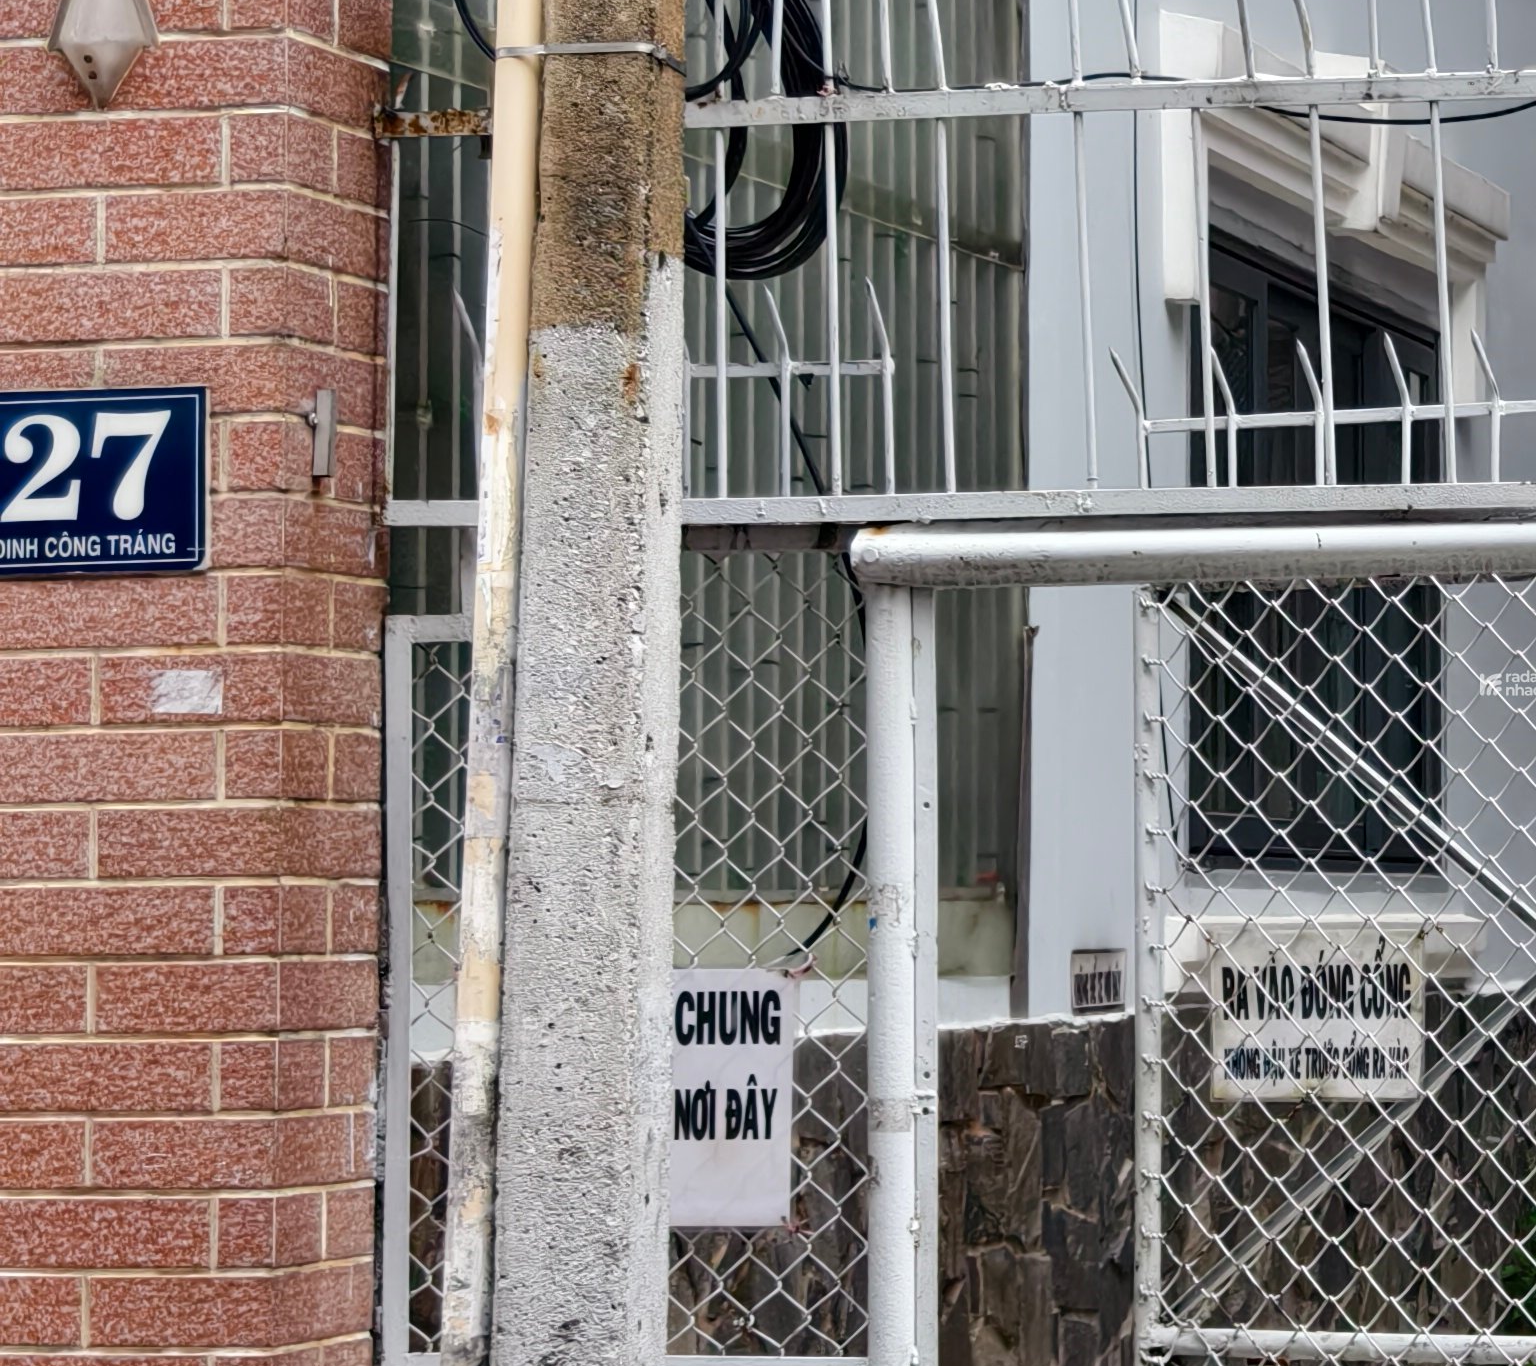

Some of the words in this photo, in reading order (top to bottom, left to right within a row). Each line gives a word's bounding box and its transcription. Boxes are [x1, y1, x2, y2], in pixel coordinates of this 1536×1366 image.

[1, 410, 171, 522] 27
[45, 532, 101, 558] CÔNG
[107, 529, 176, 556] TRÁNG
[1221, 966, 1249, 1020] RA
[1253, 951, 1295, 1020] VÀO
[1300, 950, 1354, 1020] ĐÓNG
[1360, 935, 1411, 1019] CỔNG
[674, 989, 781, 1045] CHUNG
[674, 1080, 717, 1140] NƠI
[725, 1074, 778, 1140] ĐÂY
